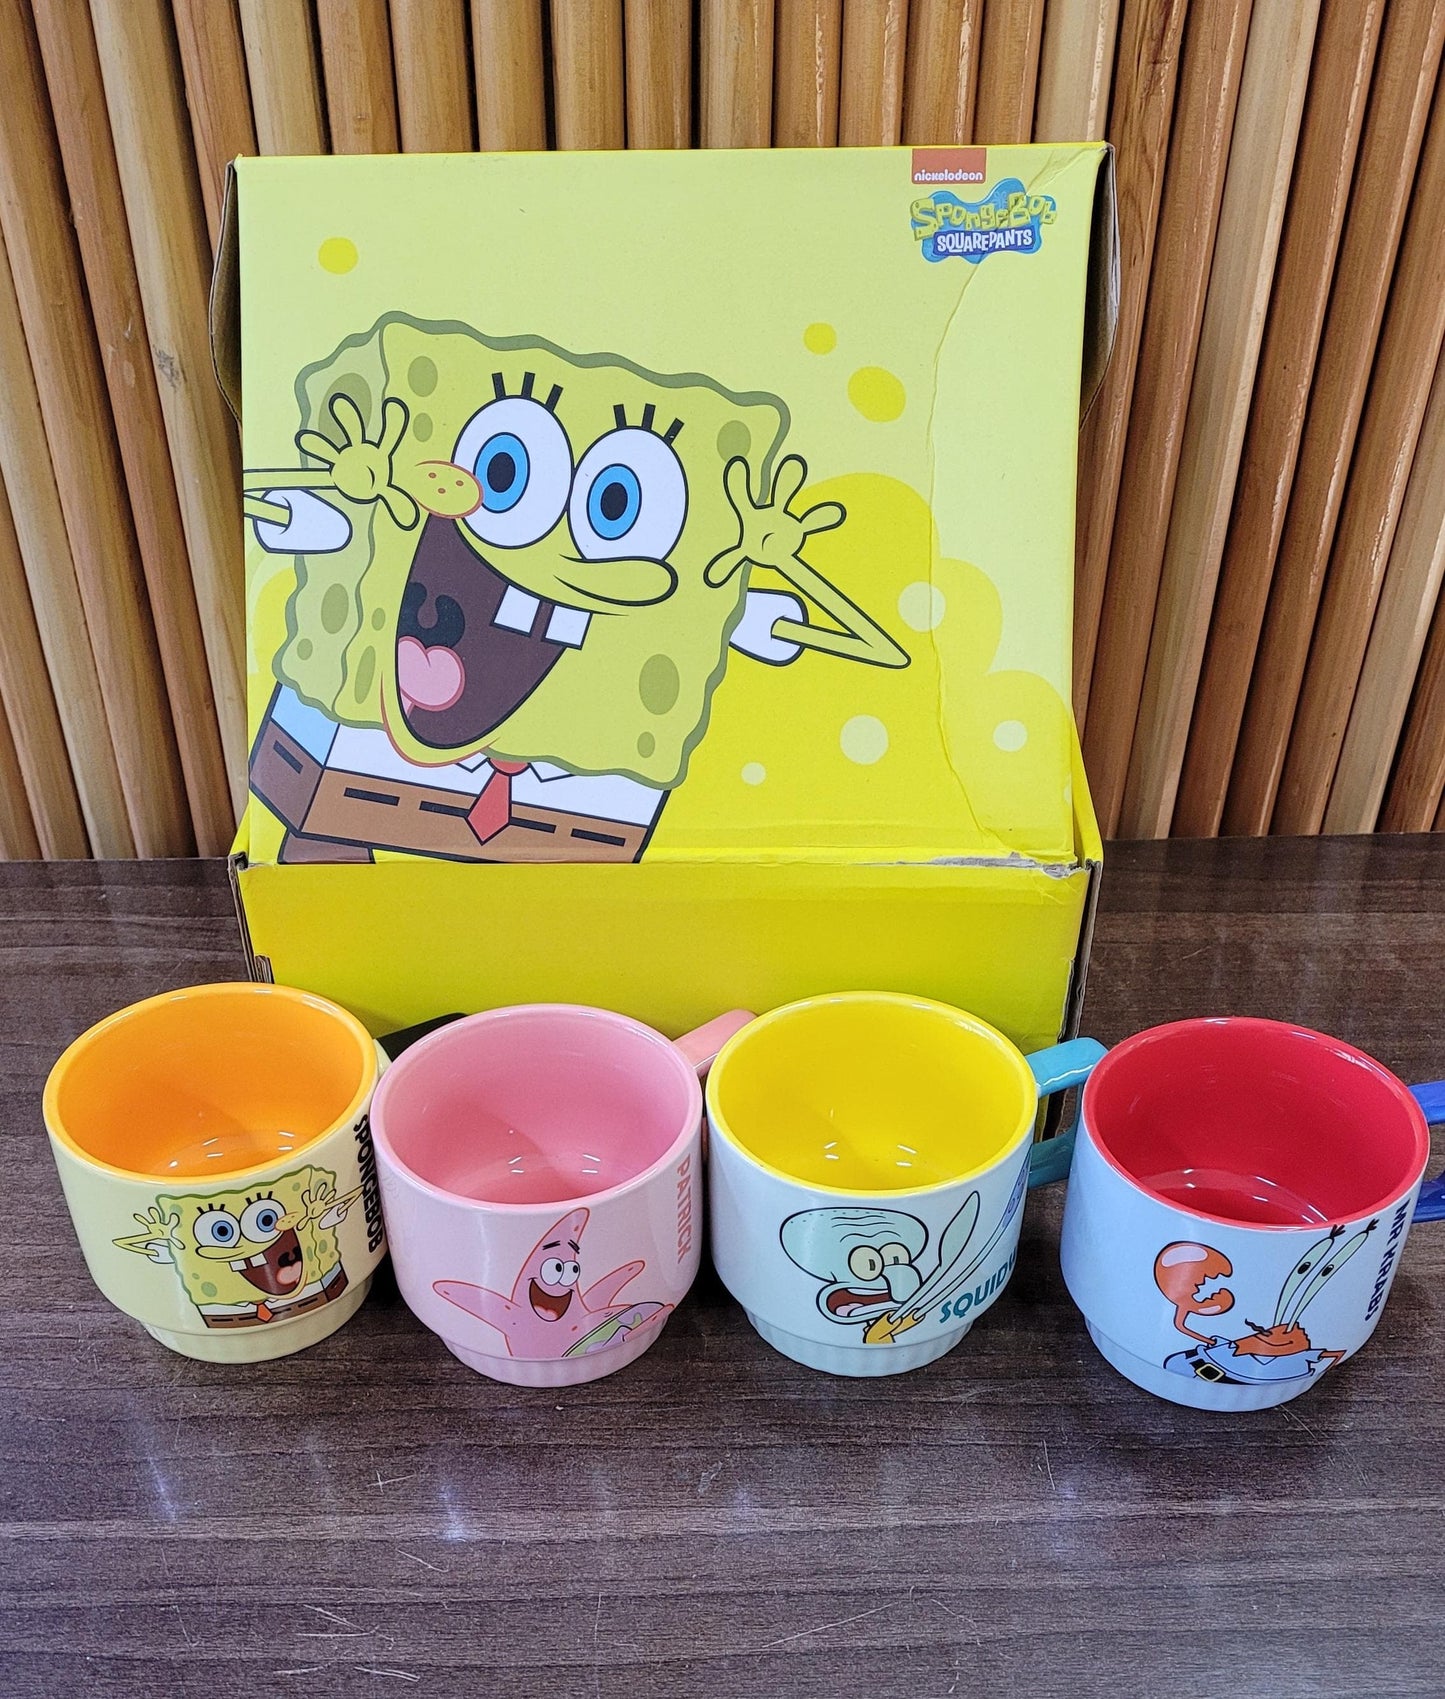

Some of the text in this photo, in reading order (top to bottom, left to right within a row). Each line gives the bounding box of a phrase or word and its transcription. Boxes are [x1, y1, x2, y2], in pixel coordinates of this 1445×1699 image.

[914, 169, 983, 181] nickelodeon
[936, 227, 1033, 253] SQUAREPANTS
[353, 1113, 384, 1253] SPONGEBOB
[677, 1152, 692, 1264] PATRICK
[1386, 1198, 1410, 1246] MR
